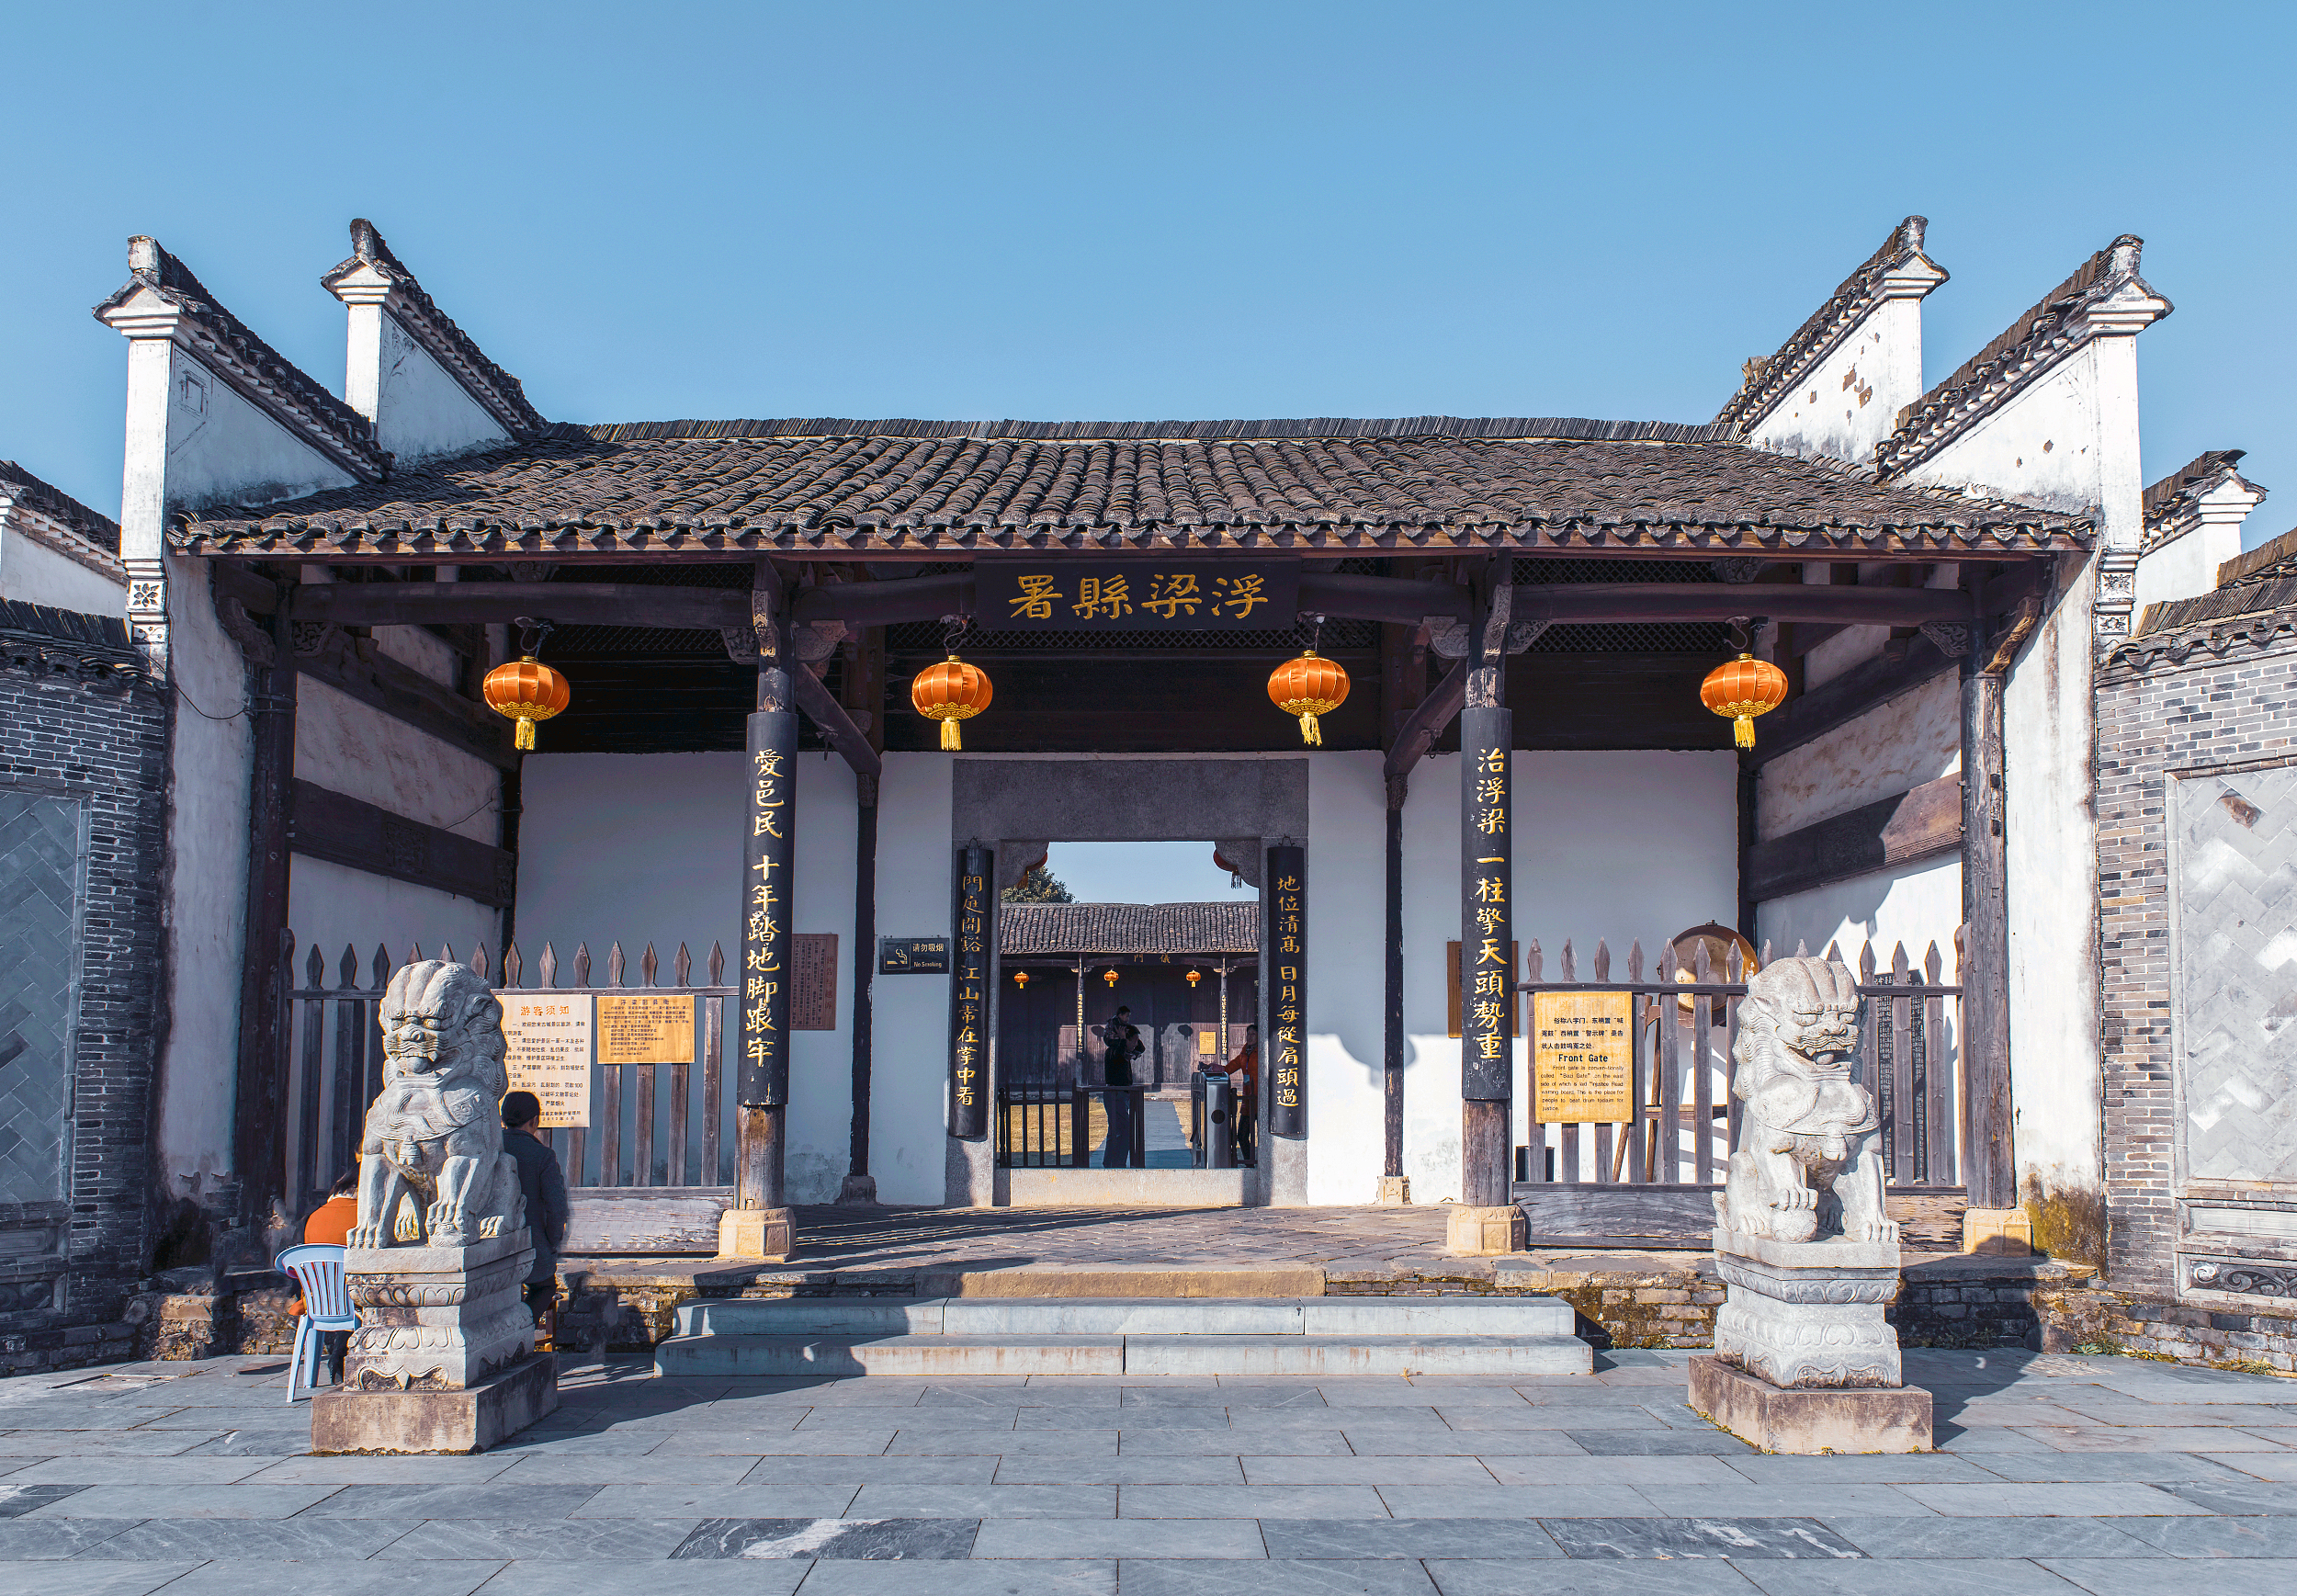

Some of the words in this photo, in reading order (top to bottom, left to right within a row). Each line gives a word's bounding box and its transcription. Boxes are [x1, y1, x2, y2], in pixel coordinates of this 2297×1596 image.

[912, 943, 945, 953] 请勿吸烟
[520, 1005, 570, 1016] 游客须知
[1558, 1054, 1583, 1062] Front
[1589, 1054, 1609, 1062] Gate
